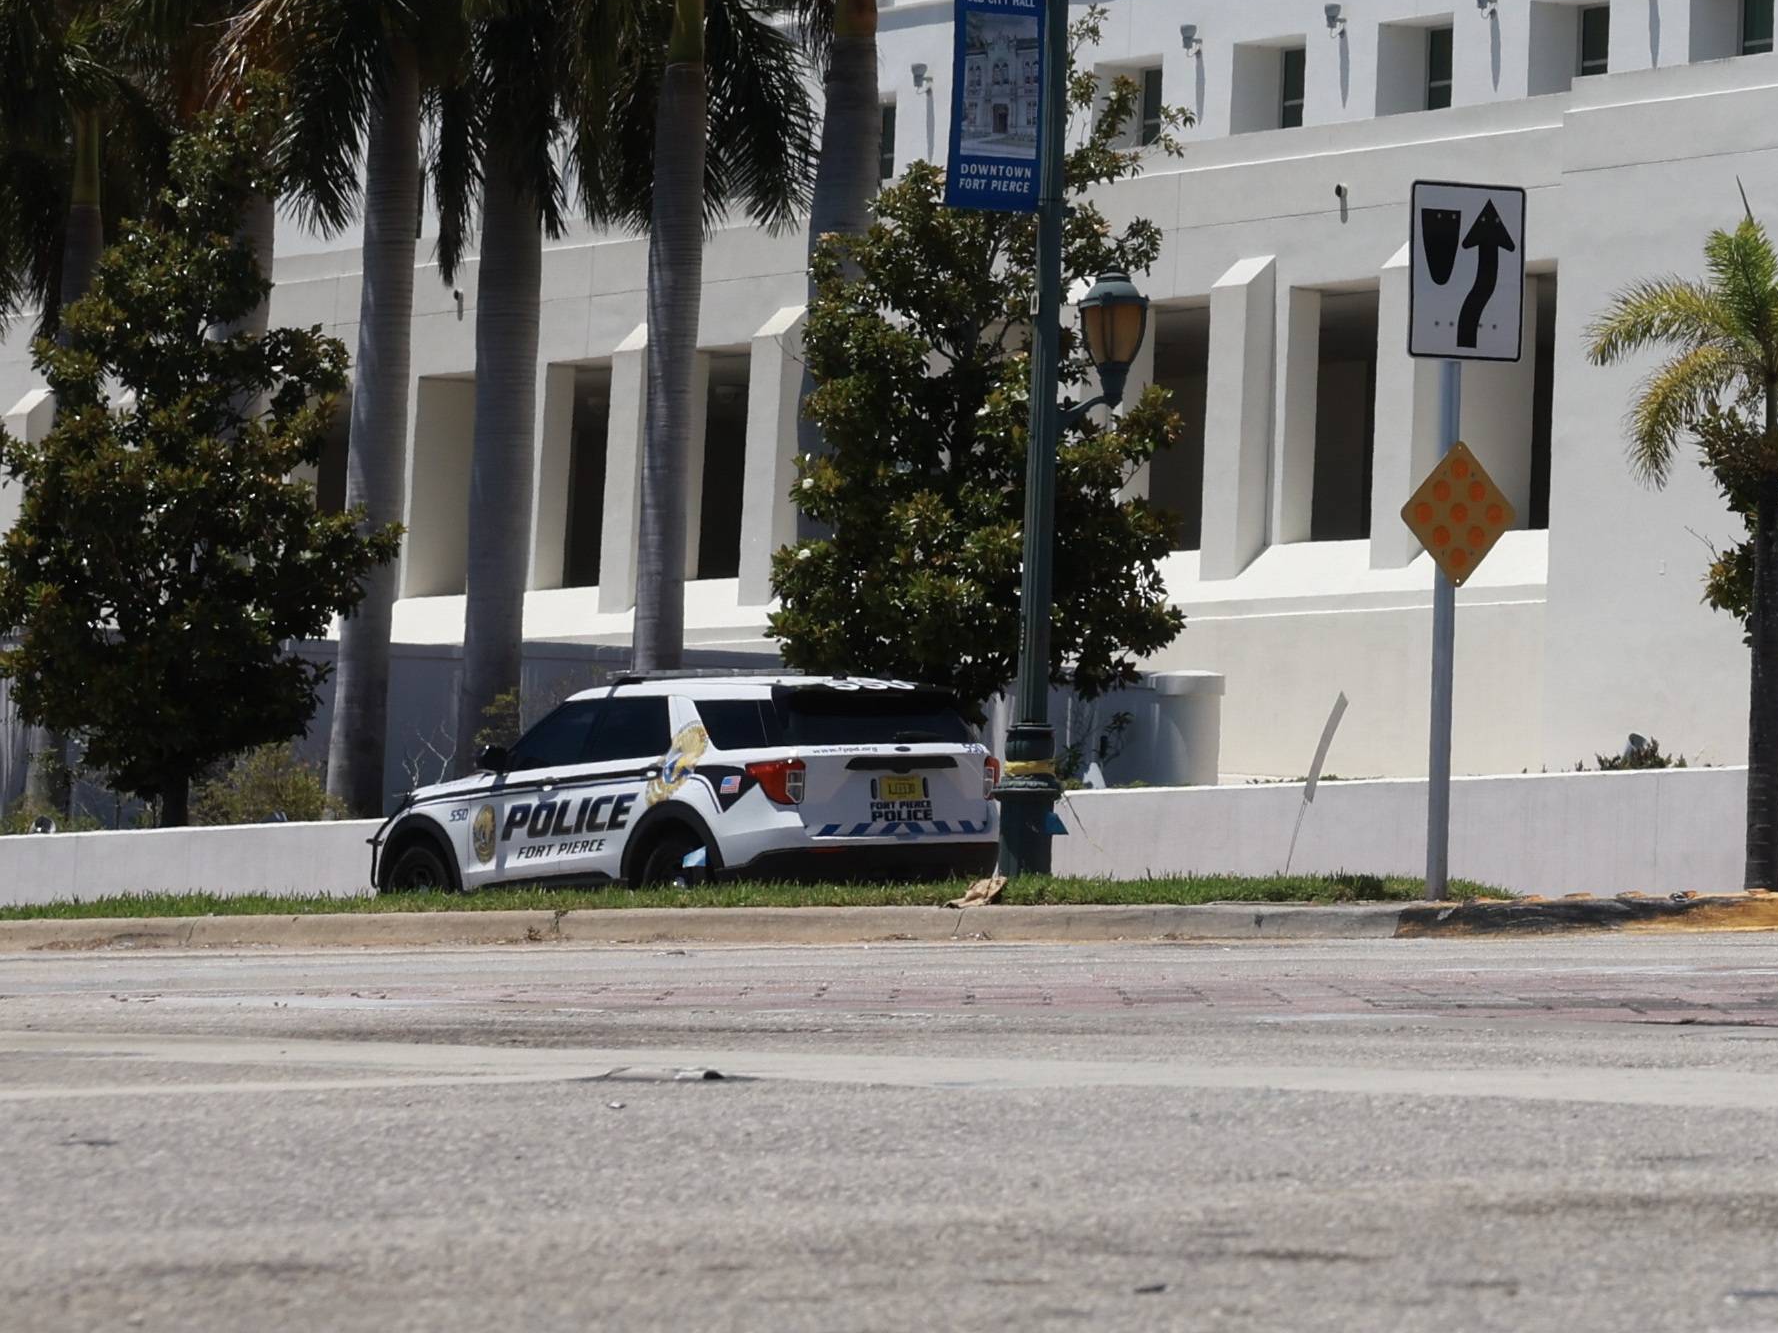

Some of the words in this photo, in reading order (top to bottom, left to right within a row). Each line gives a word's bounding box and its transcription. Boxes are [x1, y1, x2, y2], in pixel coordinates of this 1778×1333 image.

[960, 163, 1032, 179] DOWNTOWN
[959, 178, 987, 191] FORT
[991, 180, 1030, 194] PIERCE
[812, 746, 878, 755] www.fppd.org
[869, 801, 896, 810] FORT
[899, 800, 932, 809] PIERCE
[450, 808, 467, 822] 550
[501, 793, 638, 841] POLICE
[871, 809, 933, 822] POLICE
[517, 845, 554, 859] FORT
[557, 840, 606, 855] PIERCE
